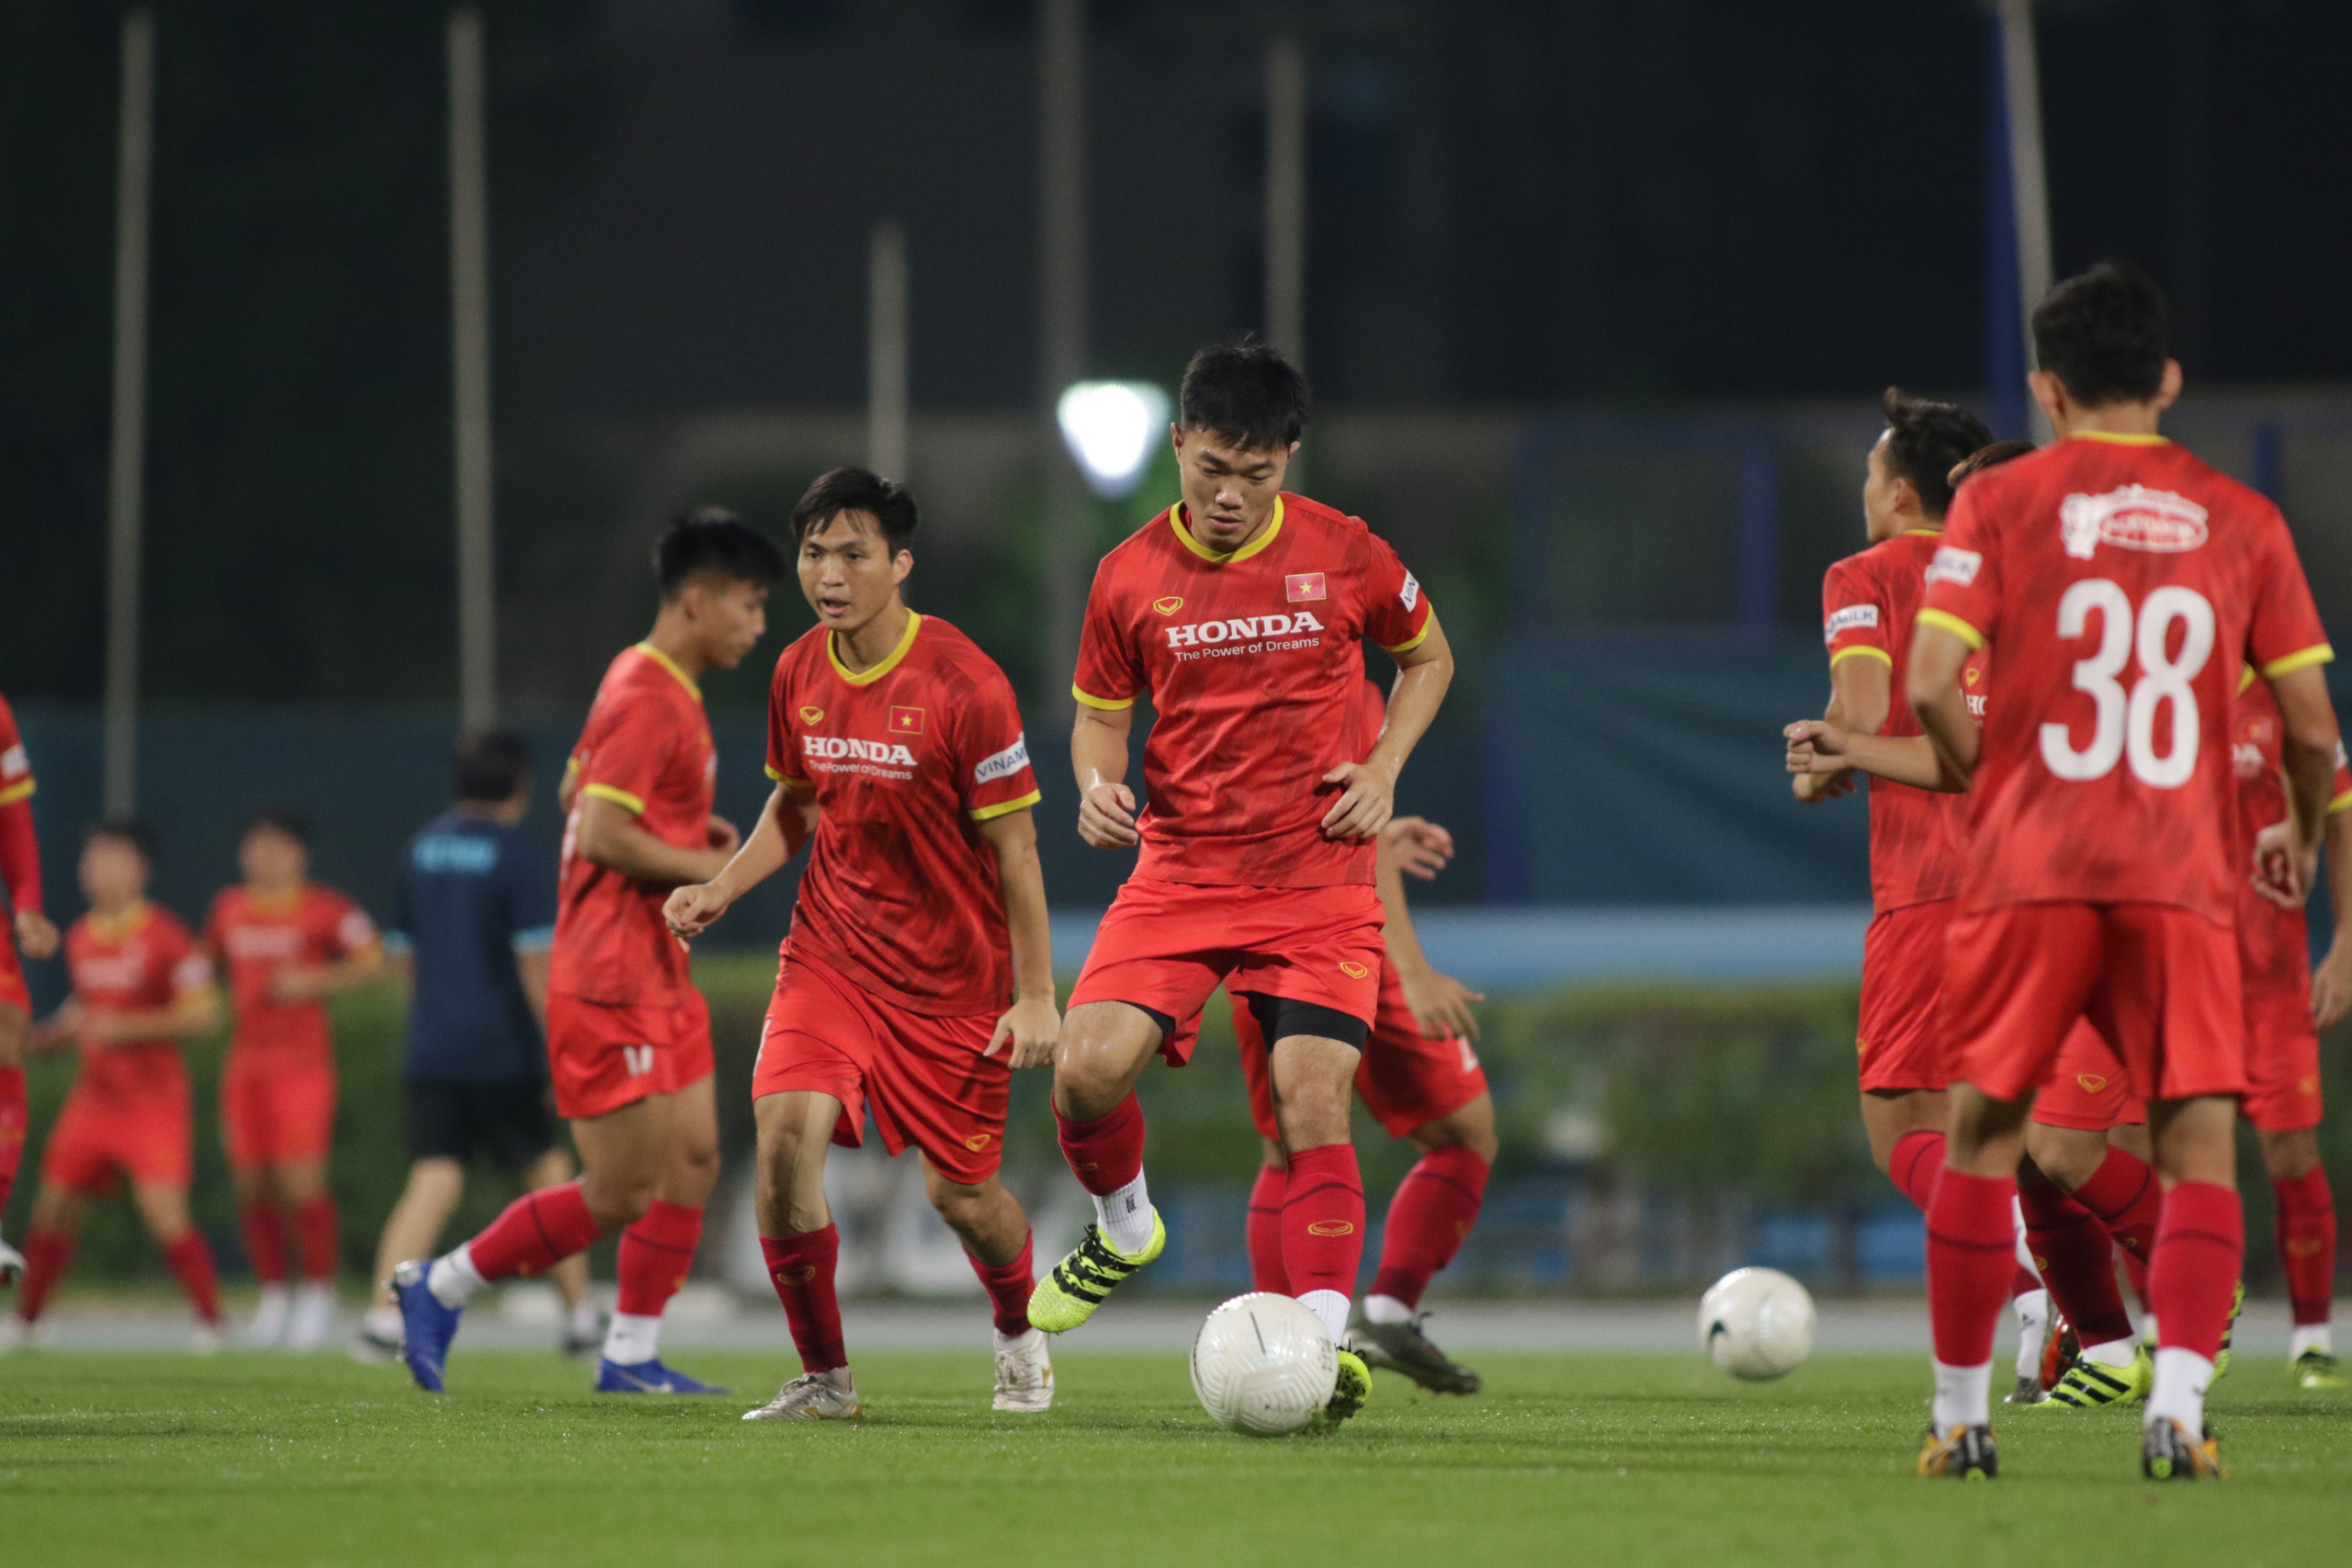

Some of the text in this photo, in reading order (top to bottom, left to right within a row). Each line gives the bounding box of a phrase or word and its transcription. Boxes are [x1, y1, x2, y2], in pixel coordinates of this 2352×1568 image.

[1165, 611, 1325, 649] HONDA
[1174, 637, 1320, 662] The Power of Dreams
[2039, 578, 2216, 789] 38
[803, 736, 918, 766] HONDA
[808, 760, 826, 772] The
[827, 761, 861, 773] Power
[871, 766, 913, 780] Dreams
